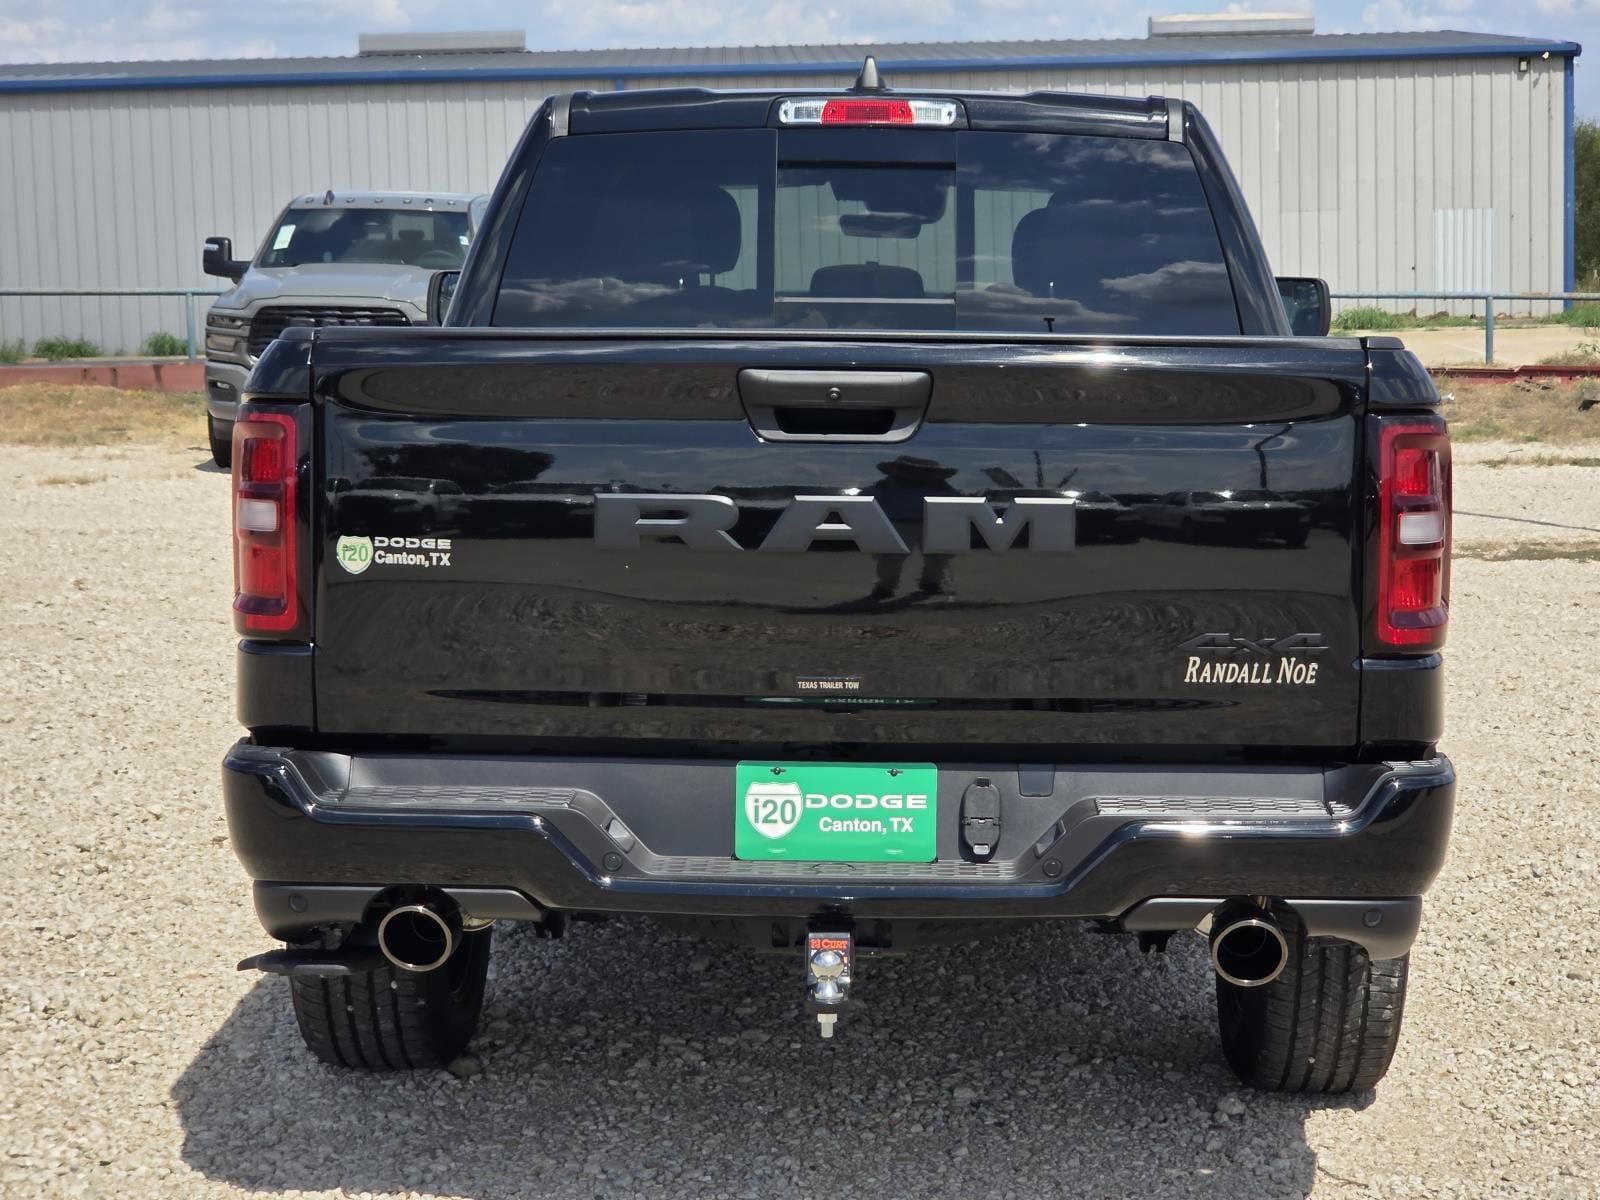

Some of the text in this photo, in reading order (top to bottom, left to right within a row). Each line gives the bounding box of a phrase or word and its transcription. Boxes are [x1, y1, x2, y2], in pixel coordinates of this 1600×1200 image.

[594, 493, 1077, 554] RAM
[374, 536, 452, 549] DODGE
[1184, 656, 1319, 684] RANDALL NOE
[798, 681, 860, 689] TEXAS TRAILER TOW
[753, 794, 928, 824] i20 DODGE
[819, 816, 914, 834] Canton, TX
